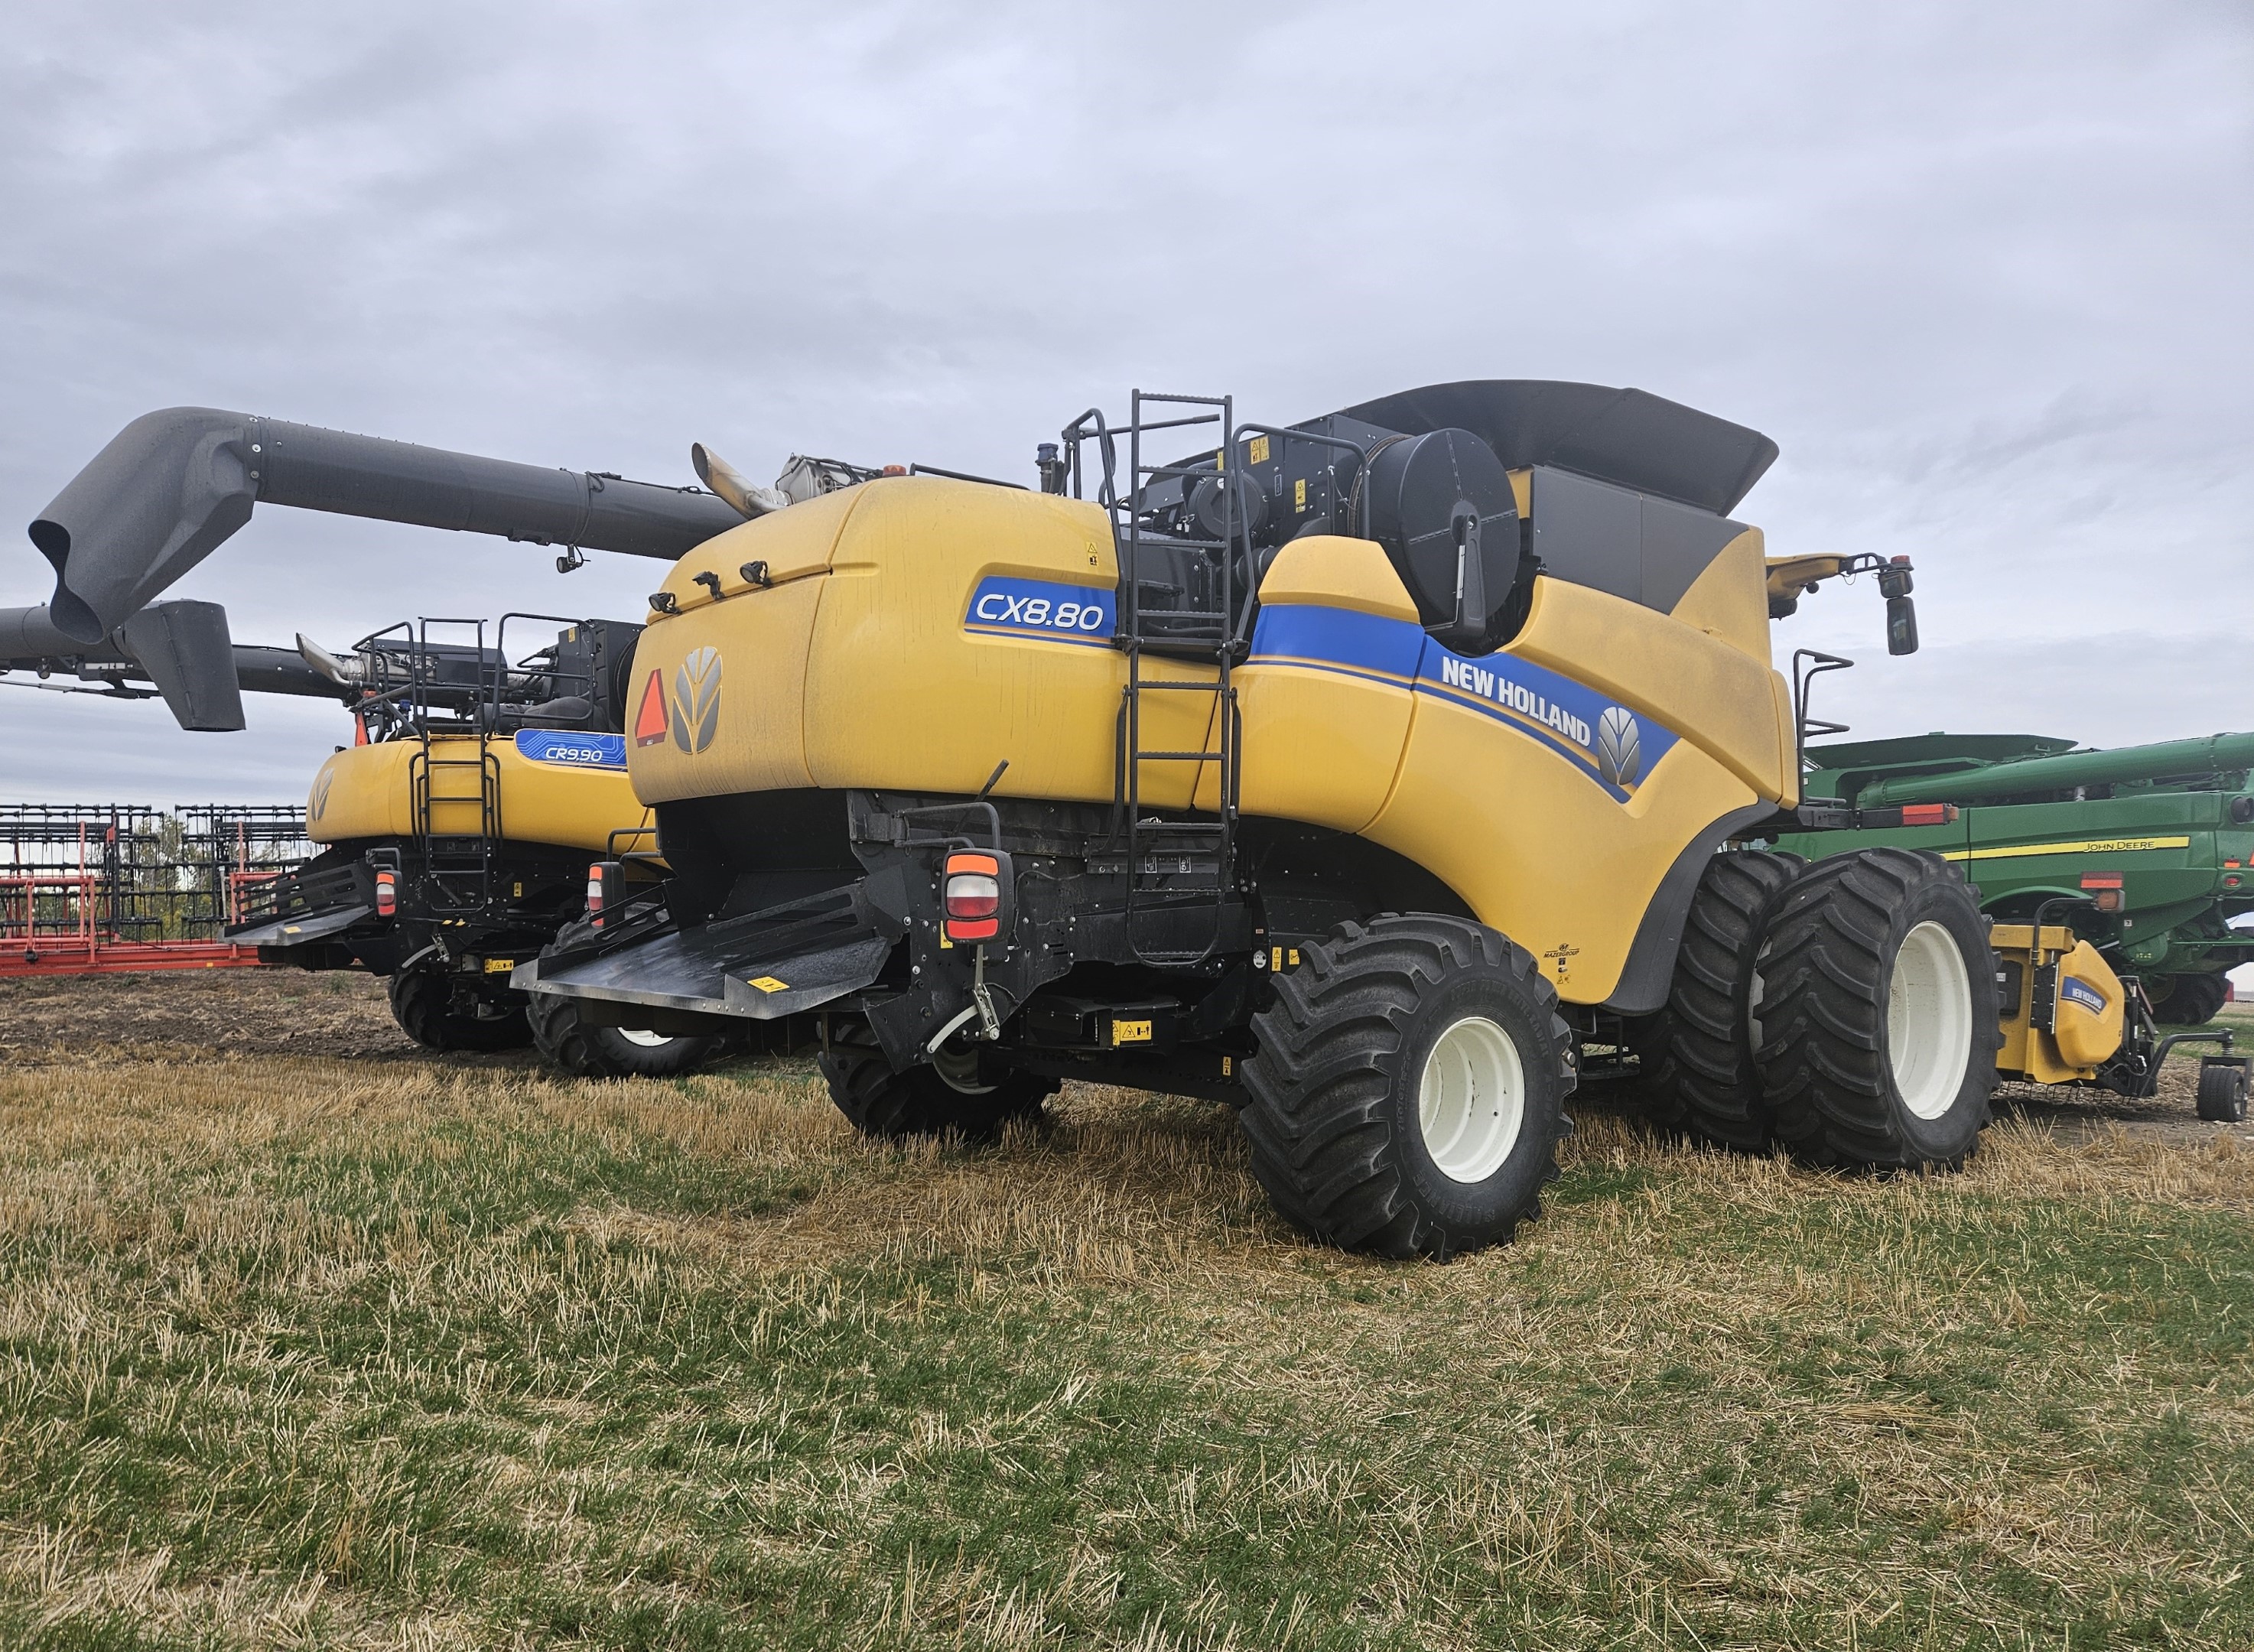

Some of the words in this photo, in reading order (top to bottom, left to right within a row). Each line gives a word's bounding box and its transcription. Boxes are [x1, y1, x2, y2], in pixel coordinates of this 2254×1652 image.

[977, 593, 1104, 631] CX8.80
[1442, 655, 1495, 698] NEW
[1498, 677, 1592, 747] HOLLAND
[545, 747, 603, 762] CR9.90
[2083, 843, 2114, 851] JOHN
[2117, 841, 2155, 850] DEERE
[2083, 990, 2102, 1009] HOLLAND
